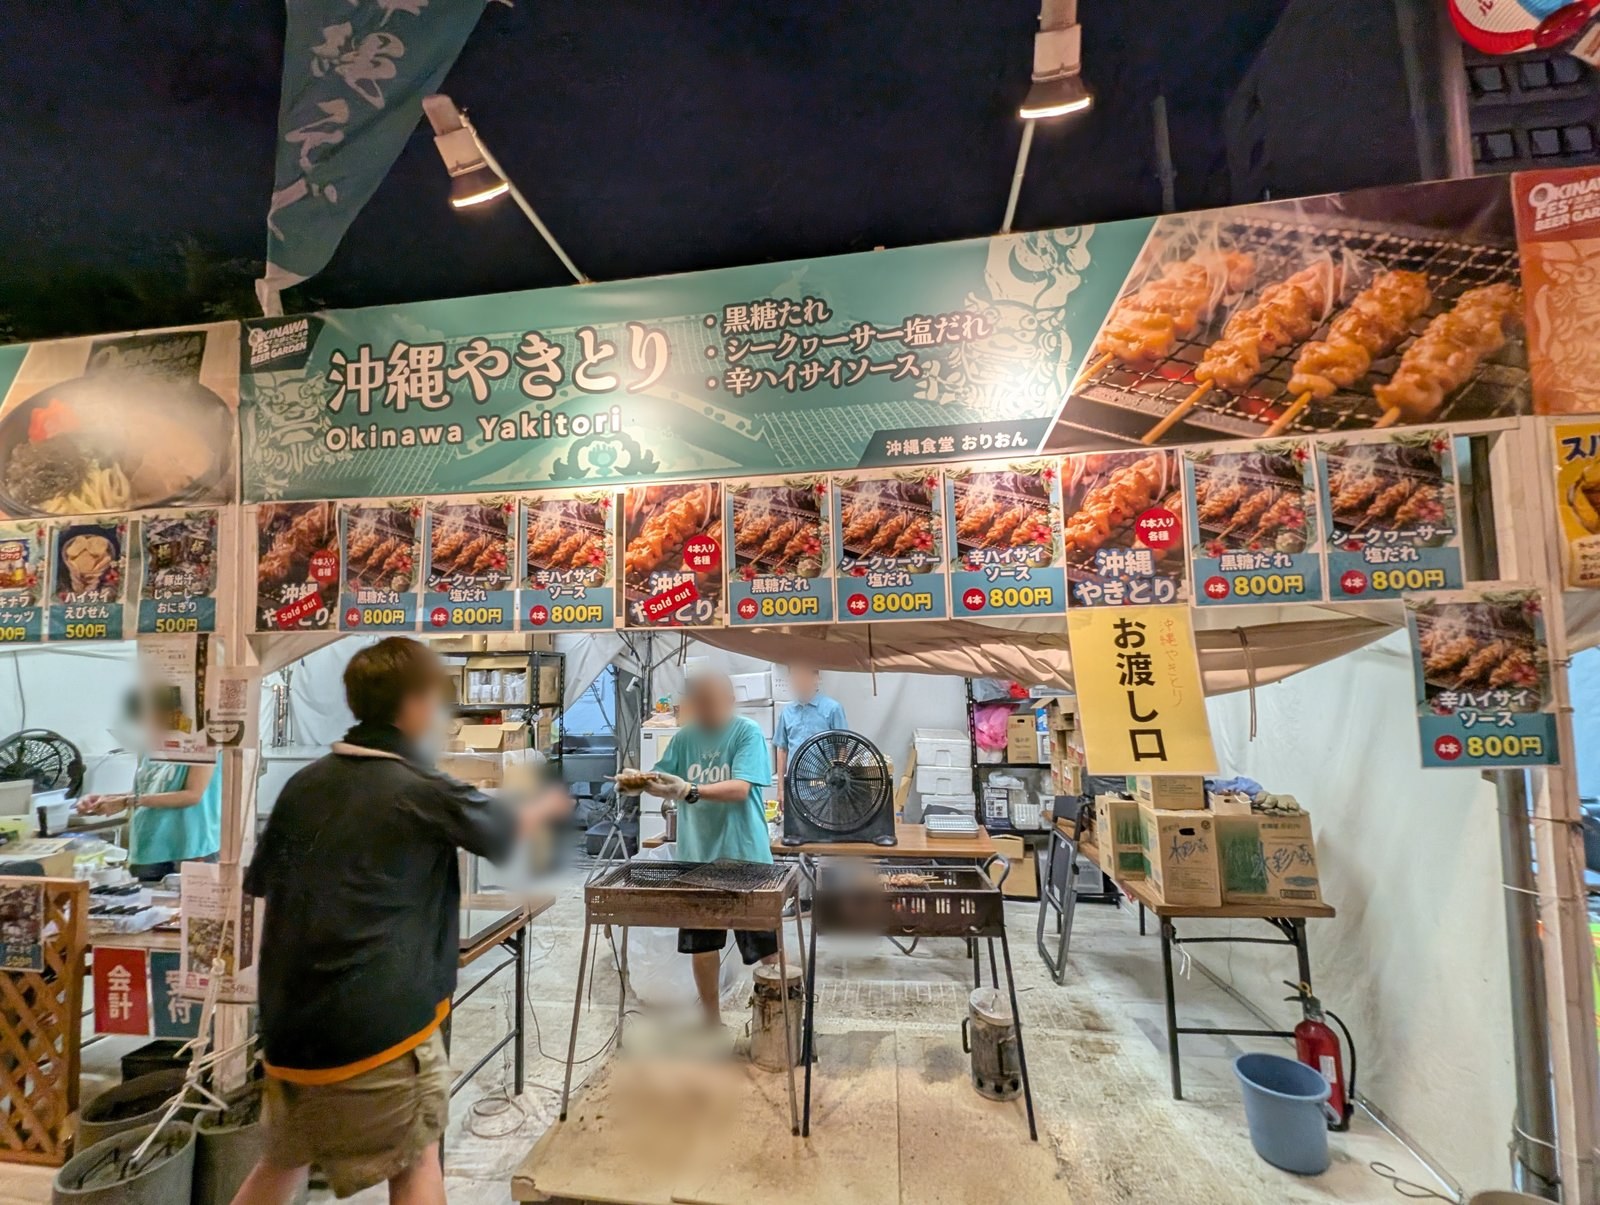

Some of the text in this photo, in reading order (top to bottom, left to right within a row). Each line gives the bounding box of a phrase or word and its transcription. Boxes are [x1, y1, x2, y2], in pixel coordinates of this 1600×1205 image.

[724, 300, 830, 332] 黒糖たれ
[248, 319, 309, 347] OKINAWA
[271, 341, 307, 358] GARDEN
[328, 324, 668, 413] 沖縄やきとり
[725, 356, 921, 395] 辛ハイサイソース
[326, 405, 622, 450] Okinawa Yakitori
[886, 433, 1029, 456] 沖縄食堂 おりおん
[1140, 517, 1175, 529] 4本入り
[1147, 530, 1171, 542] 各種
[687, 543, 716, 553] 4本入り
[969, 547, 1043, 565] 辛ハイサイ
[1365, 547, 1419, 564] 塩だれ
[693, 556, 711, 565] 各種
[1098, 551, 1153, 577] 沖縄
[1220, 552, 1292, 571] 黒糖たれ
[537, 569, 598, 583] 辛ハイサイ
[867, 572, 912, 587] 塩だれ
[986, 566, 1031, 582] ソース
[1345, 570, 1445, 591] 4本 800円
[549, 586, 587, 600] ソース
[751, 578, 809, 594] 黒糖たれ
[1076, 580, 1175, 606] やきとり
[1207, 575, 1304, 596] 4本 800円
[65, 591, 110, 603] ハイサイ
[154, 589, 204, 600] じゅーしー
[357, 591, 400, 604] 黒糖たれ
[449, 589, 487, 602] 塩だれ
[649, 587, 692, 614] Sold out
[850, 593, 932, 611] 4本 800円
[966, 587, 1052, 607] 4本 800円
[65, 606, 110, 620] えびせん
[157, 602, 197, 613] おにぎり
[280, 598, 317, 622] Sold out
[531, 605, 602, 623] 4本 800円
[740, 597, 818, 616] 4本 800円
[0, 611, 35, 624] ナッツ
[363, 609, 405, 624] 800円
[433, 608, 503, 624] 4本 800円
[66, 624, 107, 639] 500円
[155, 618, 198, 632] 500円
[1112, 617, 1168, 762] お渡し口
[1439, 690, 1529, 708] 辛ハイサイ
[1460, 712, 1515, 728] ソース
[1438, 735, 1543, 757] 4本 800円
[107, 964, 134, 1021] 会計
